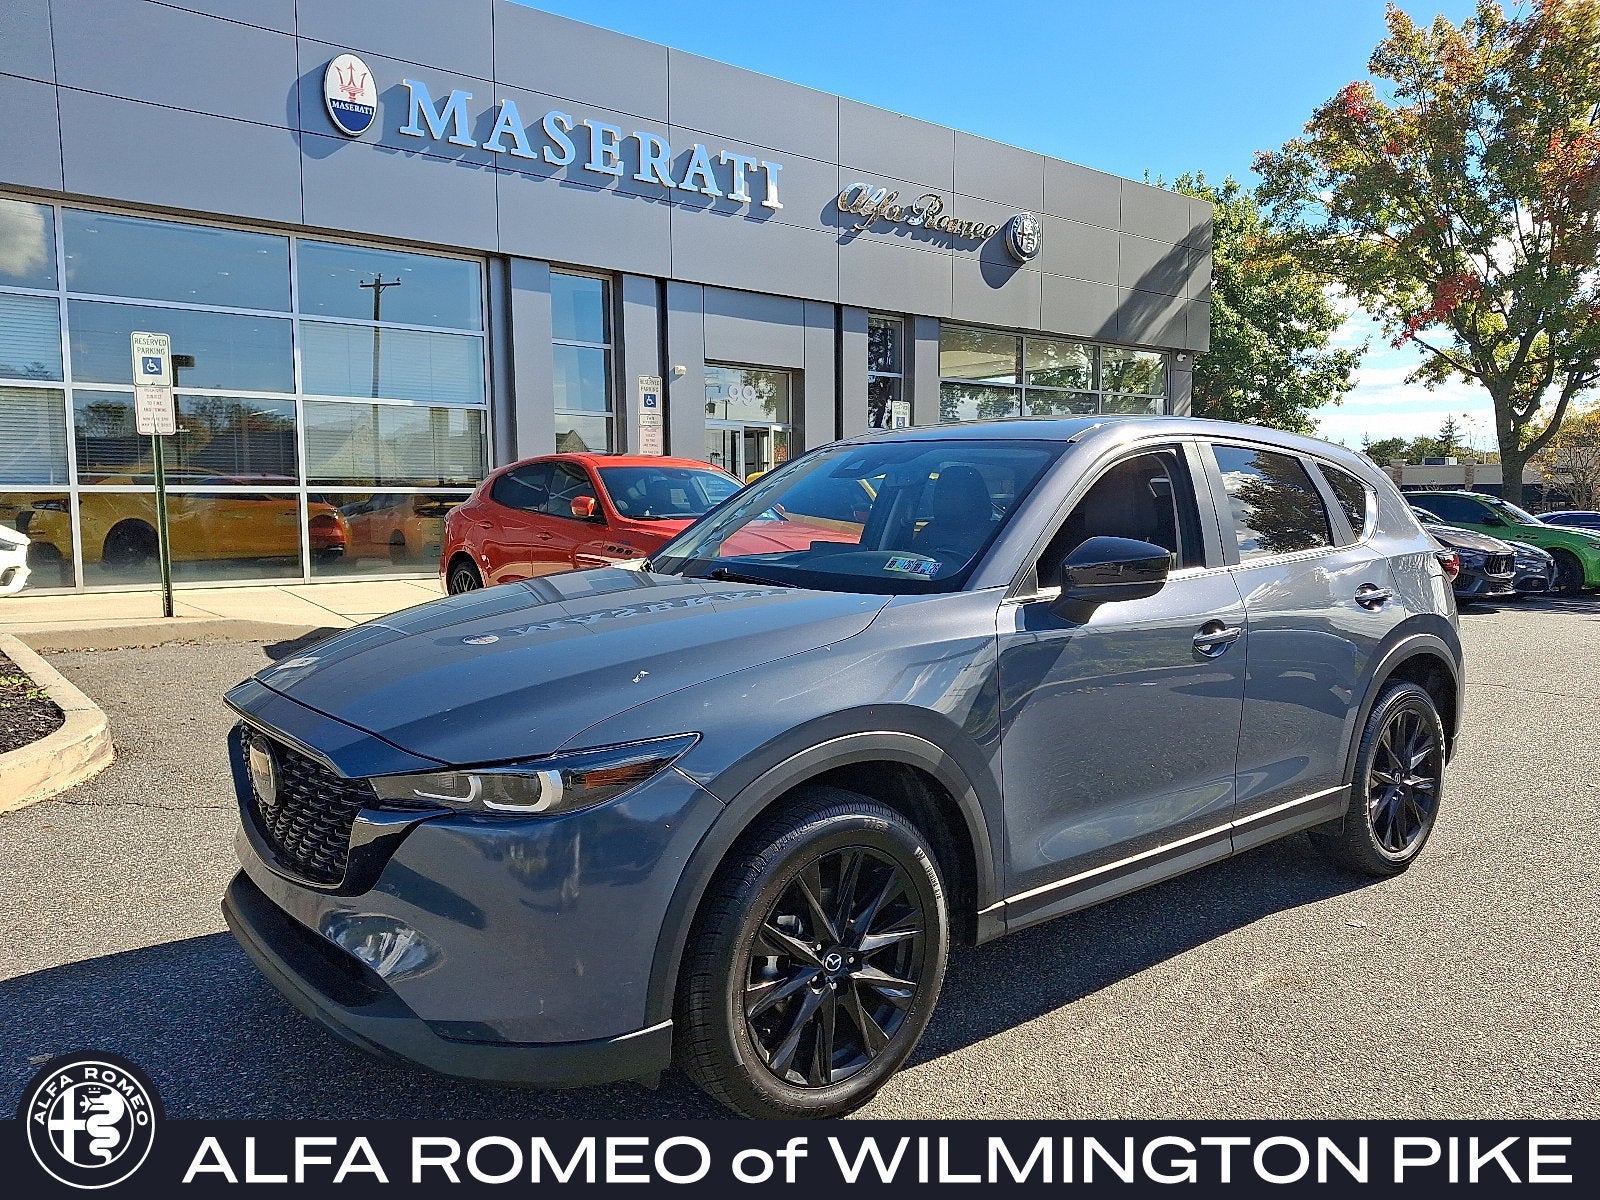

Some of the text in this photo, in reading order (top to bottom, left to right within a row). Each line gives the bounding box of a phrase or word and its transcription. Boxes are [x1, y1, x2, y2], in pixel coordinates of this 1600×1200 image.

[331, 101, 373, 115] MASERATI
[400, 78, 784, 209] MASERATI
[837, 182, 904, 230] Alfa
[906, 193, 1000, 239] Romeo
[134, 337, 167, 347] RESERVED
[137, 347, 166, 355] PARKING
